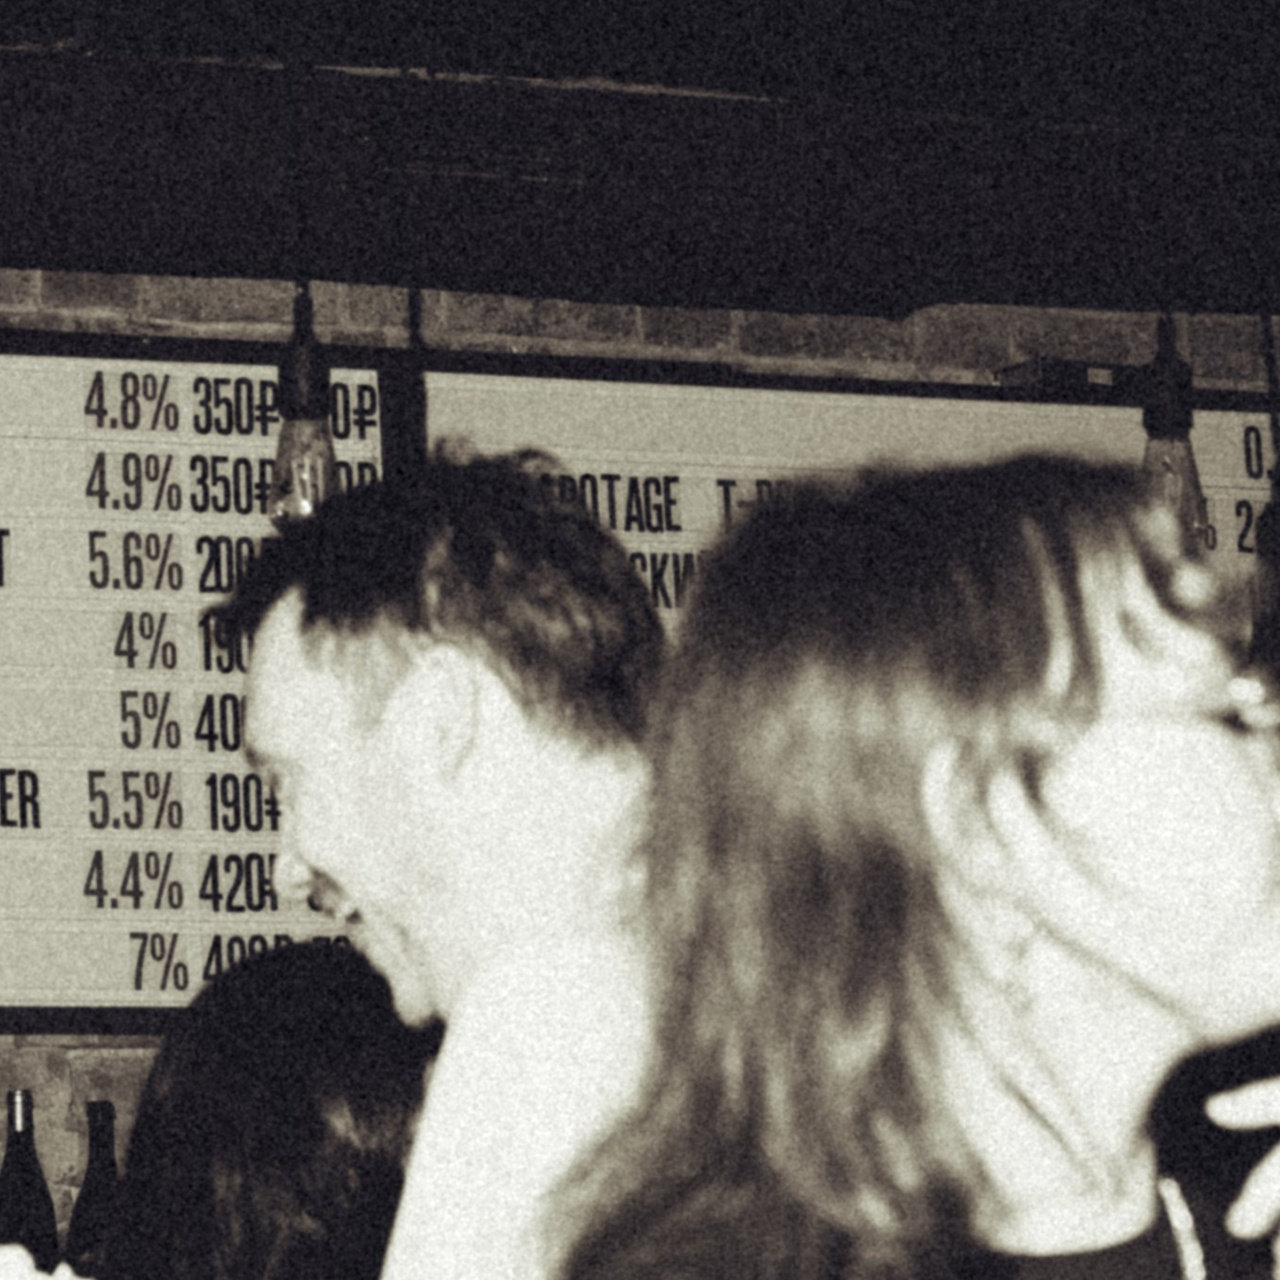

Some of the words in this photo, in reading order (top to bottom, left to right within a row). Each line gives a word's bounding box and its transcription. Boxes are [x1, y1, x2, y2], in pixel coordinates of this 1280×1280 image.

[84, 370, 179, 431] 4.8%
[85, 452, 181, 511] 4.9%
[88, 531, 184, 590] 5.6%
[195, 535, 255, 593] 200
[114, 611, 178, 670] 4%
[121, 690, 181, 749] 5%
[88, 770, 183, 830] 5.5%
[84, 850, 183, 909] 4.4%
[130, 932, 189, 991] 7%
